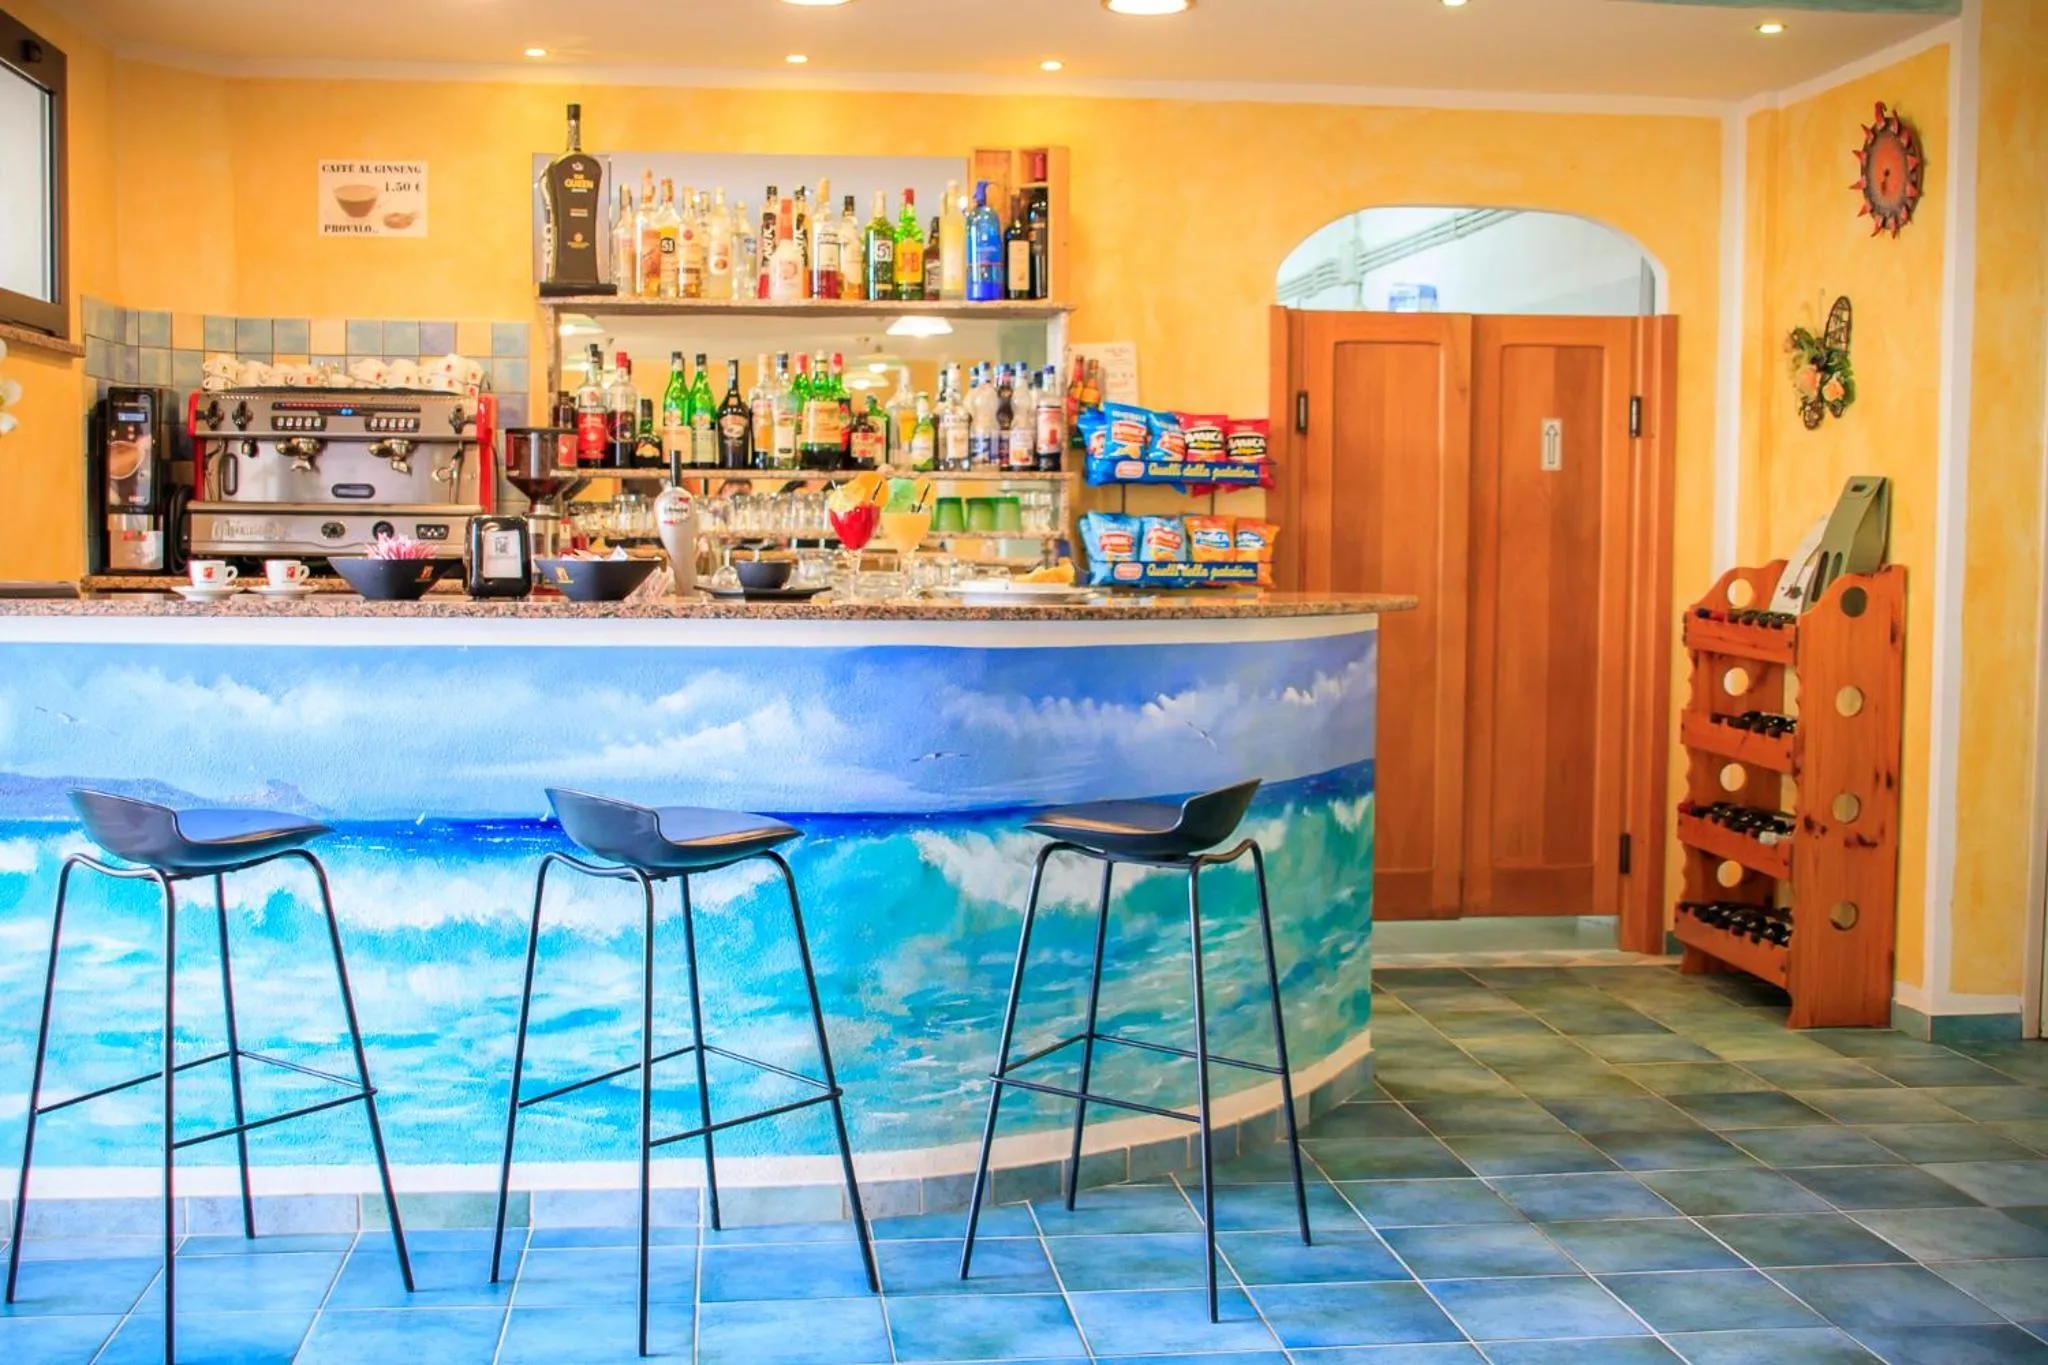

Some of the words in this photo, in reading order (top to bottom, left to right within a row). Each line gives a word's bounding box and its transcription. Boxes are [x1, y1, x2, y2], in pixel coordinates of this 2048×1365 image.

[359, 164, 372, 173] AL
[385, 181, 410, 192] 1.50
[877, 242, 891, 259] 51
